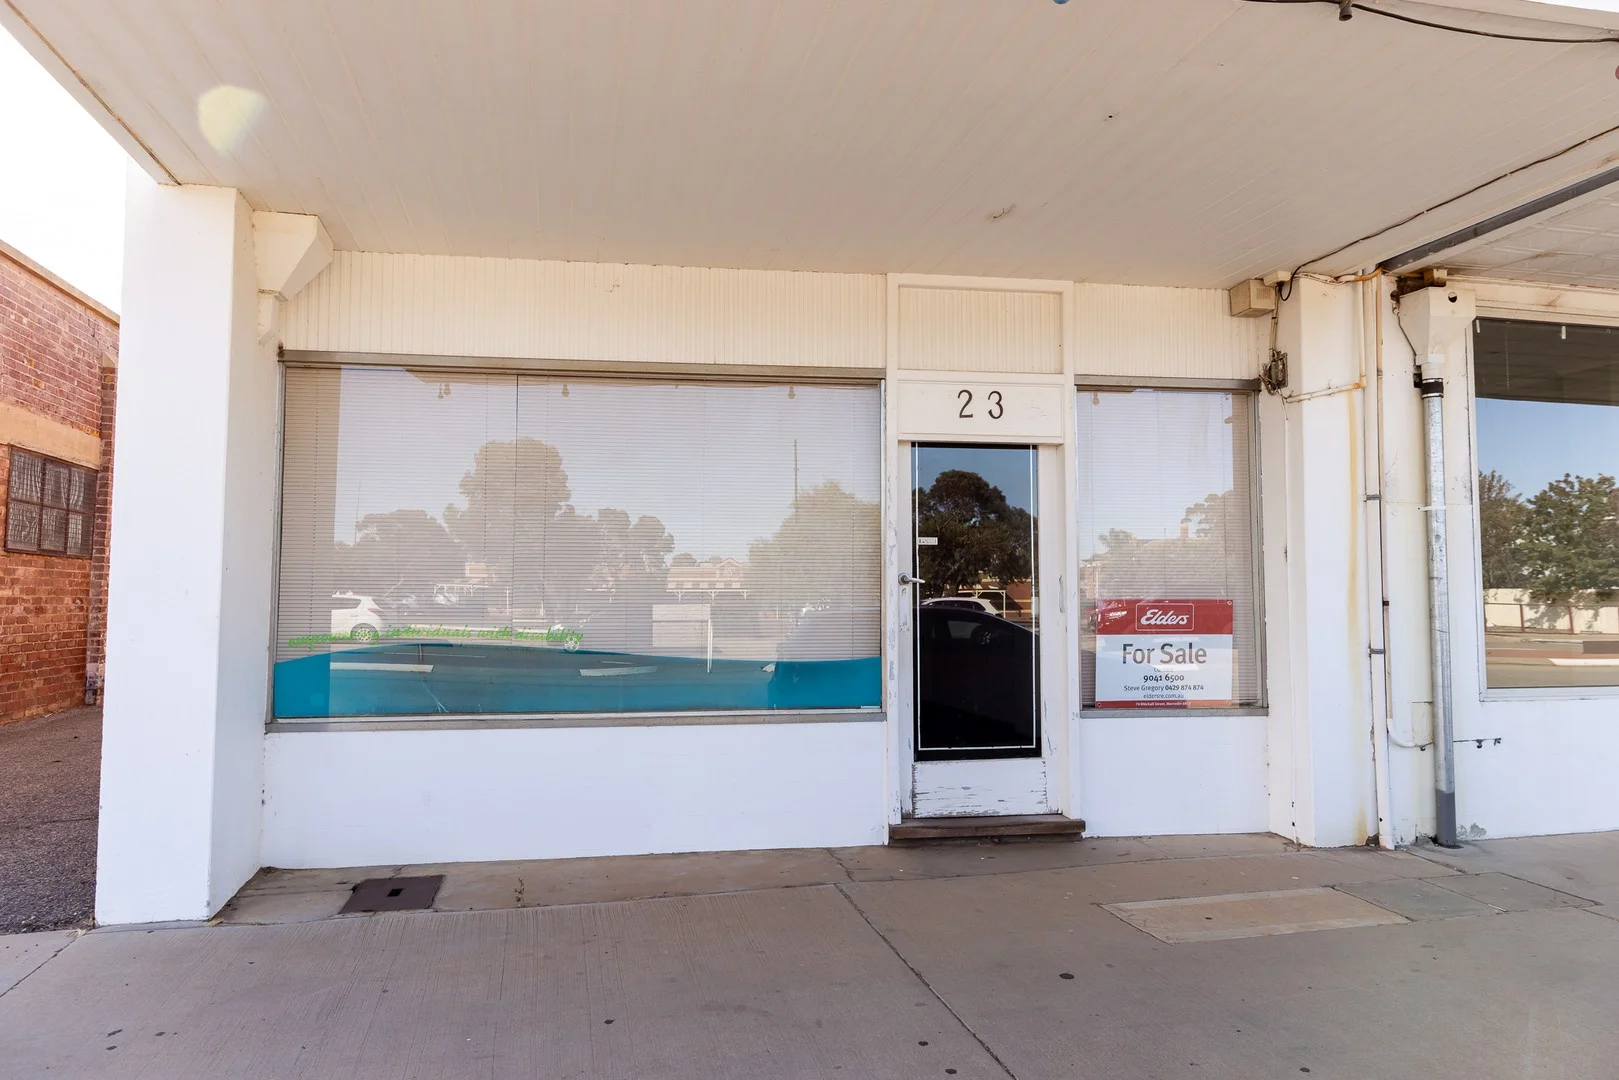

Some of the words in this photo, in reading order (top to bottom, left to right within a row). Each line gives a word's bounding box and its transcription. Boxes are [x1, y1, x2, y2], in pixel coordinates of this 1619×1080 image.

[957, 389, 1004, 420] 23
[1140, 608, 1190, 625] Elders
[385, 623, 472, 639] individuals
[477, 625, 512, 640] with
[514, 626, 584, 648] disability
[1122, 643, 1155, 665] For
[1160, 642, 1207, 665] Sale
[1123, 684, 1140, 692] Steve
[1140, 684, 1164, 692] Gregory
[1143, 674, 1163, 683] 9041
[1164, 673, 1185, 683] 6500
